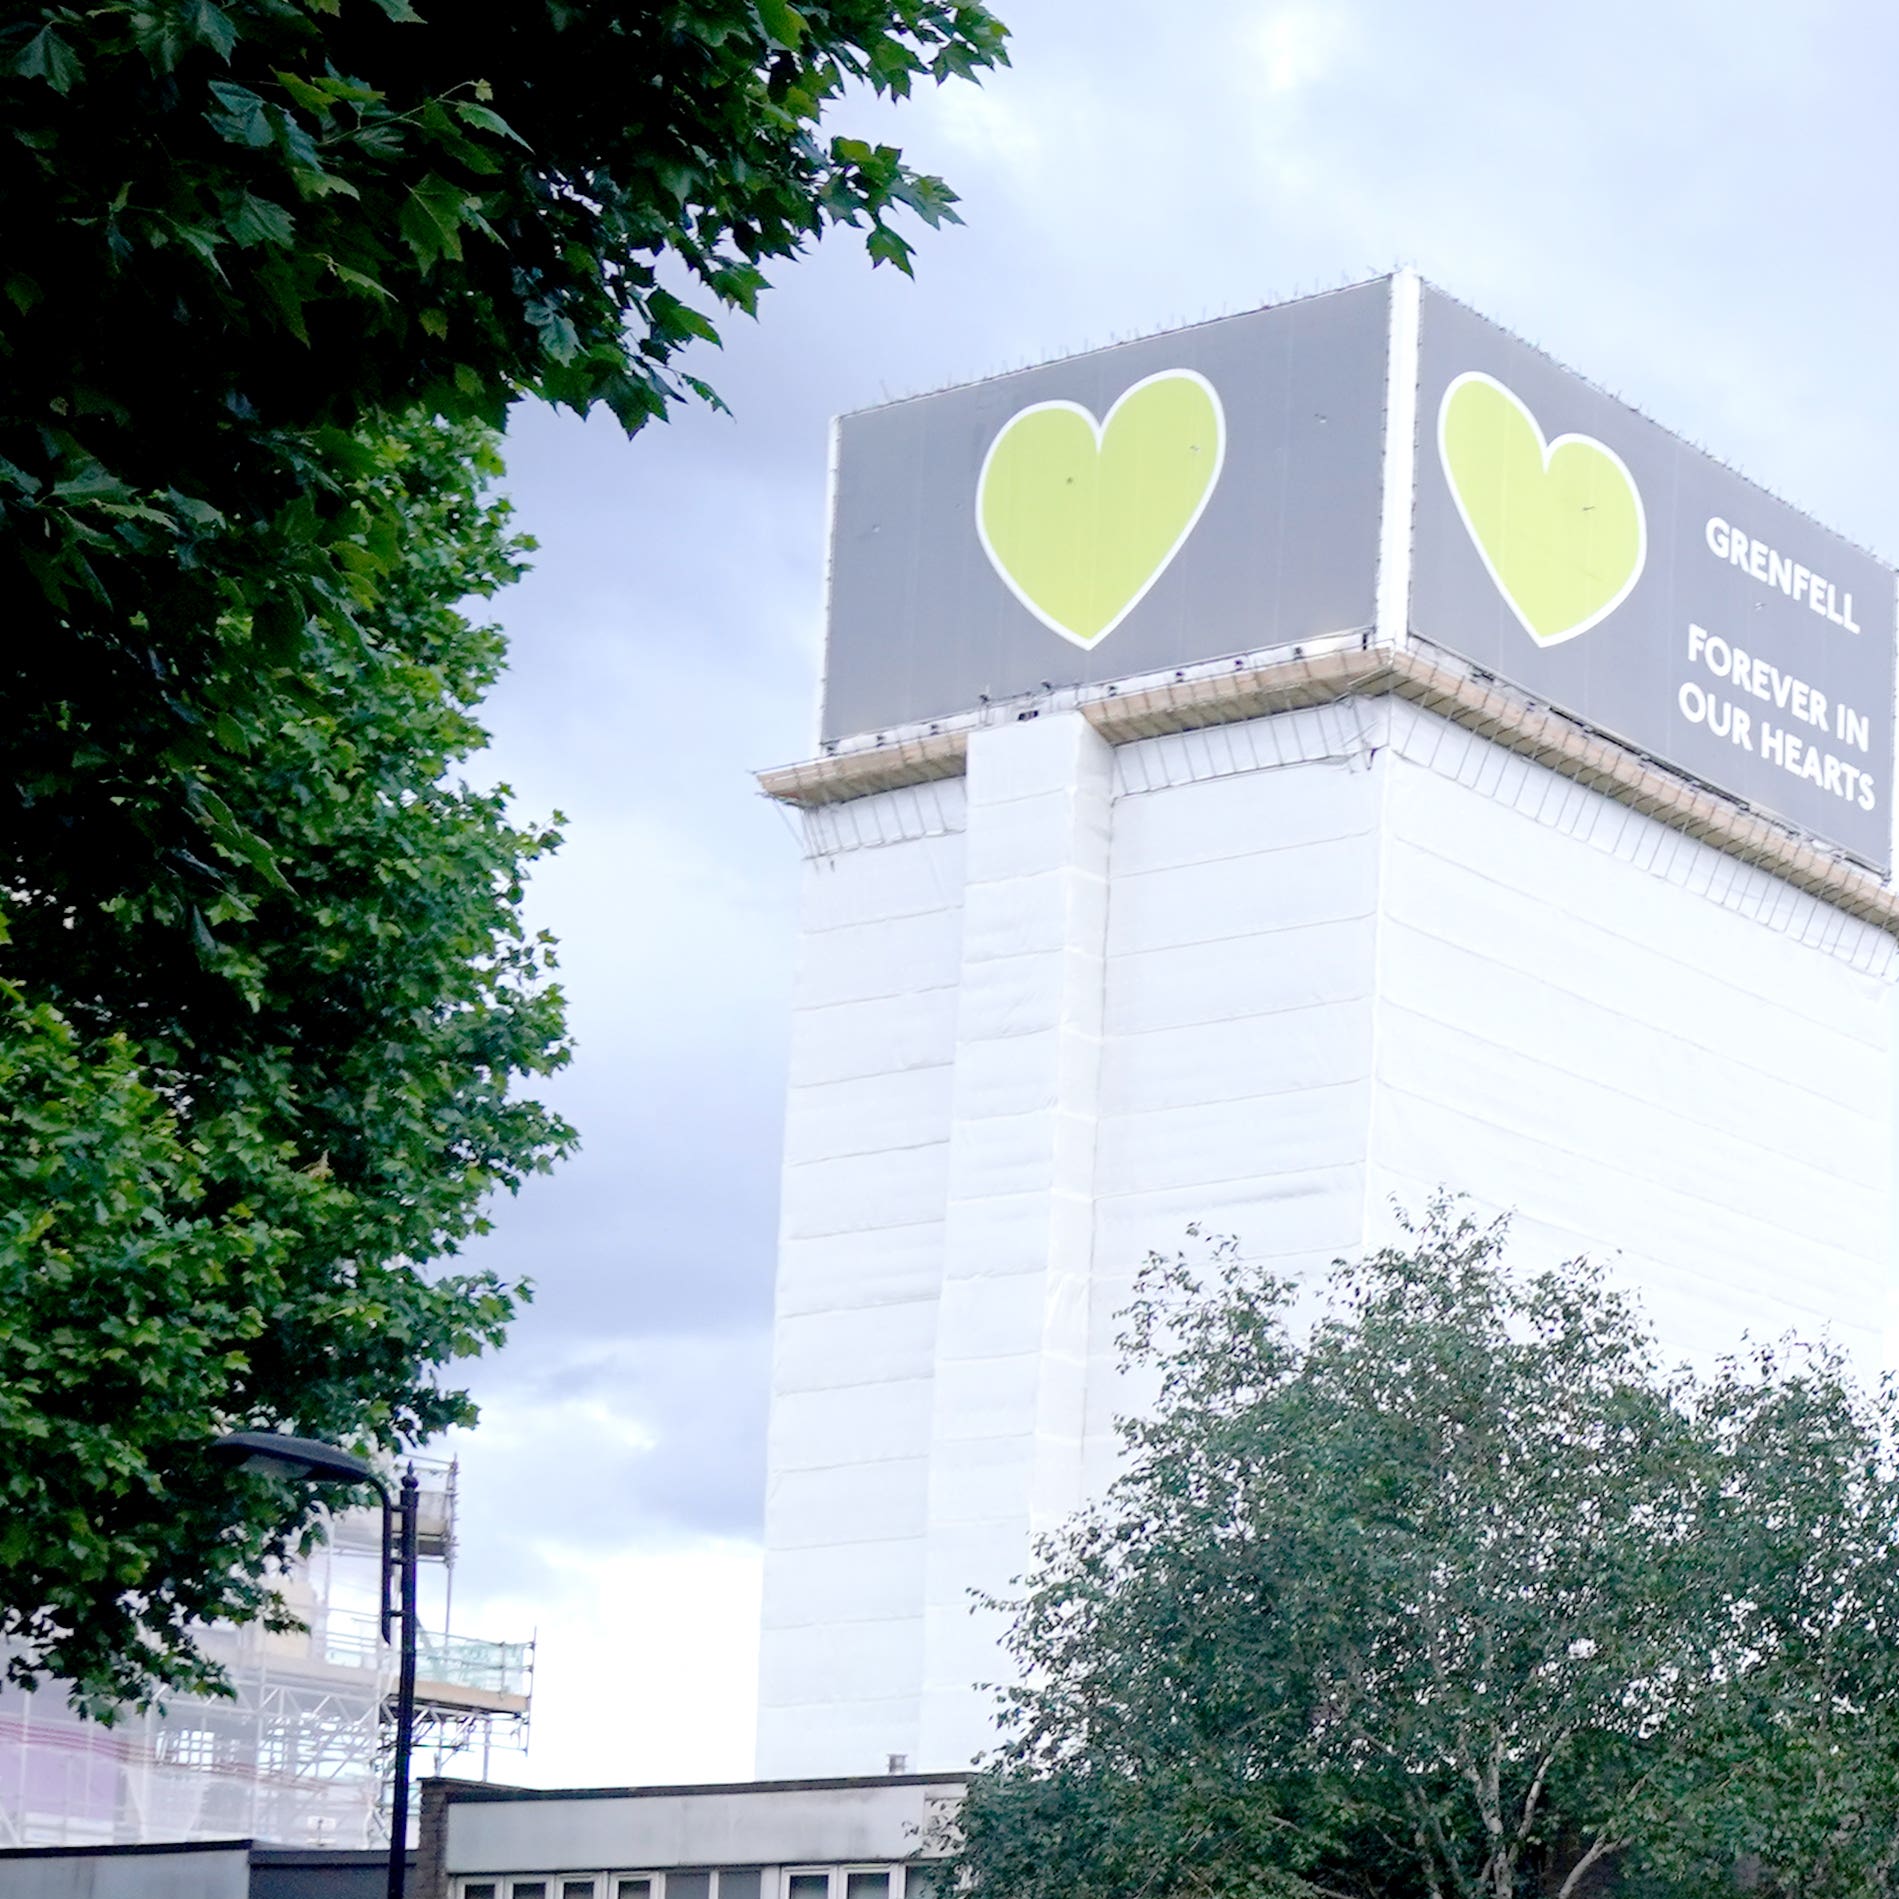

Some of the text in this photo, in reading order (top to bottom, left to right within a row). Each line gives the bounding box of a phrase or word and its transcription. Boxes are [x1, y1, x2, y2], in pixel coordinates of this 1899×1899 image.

[1705, 516, 1861, 634] GRENFELL
[1678, 682, 1876, 811] OUR HEARTS
[1688, 623, 1870, 753] FOREVER IN
